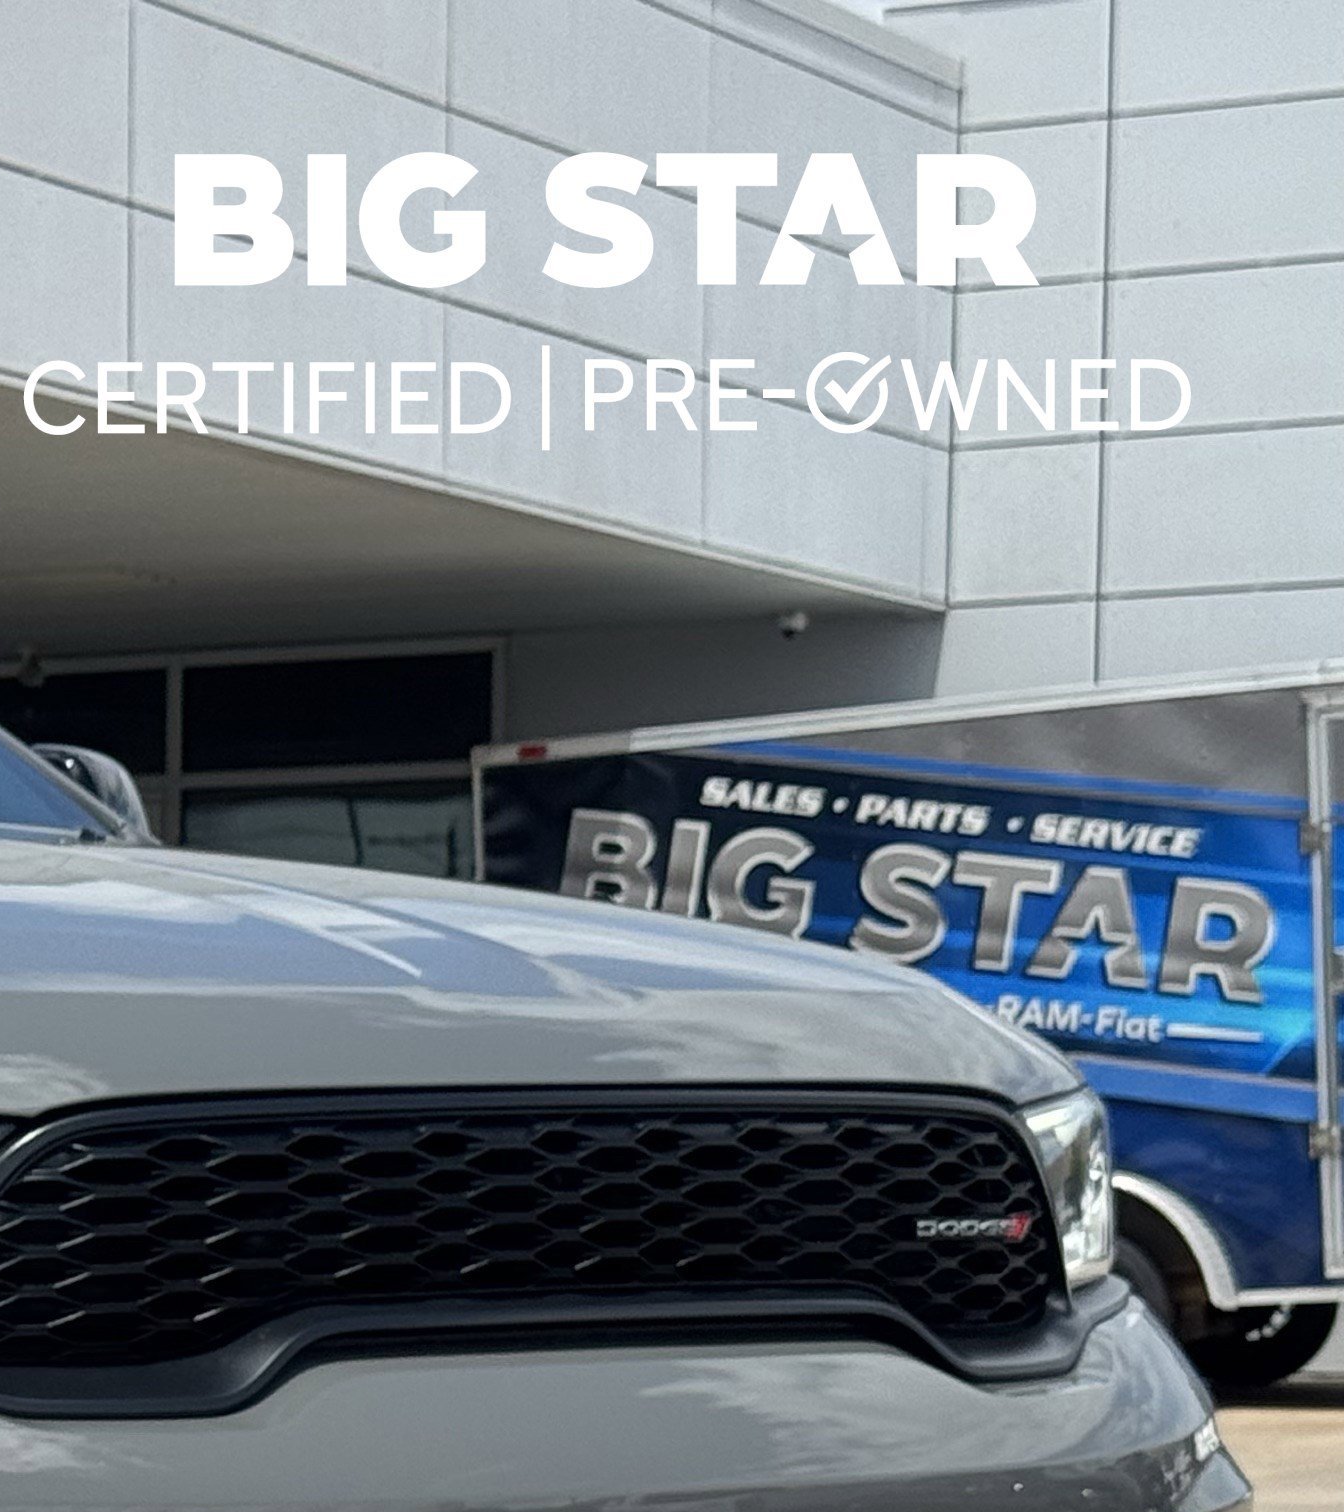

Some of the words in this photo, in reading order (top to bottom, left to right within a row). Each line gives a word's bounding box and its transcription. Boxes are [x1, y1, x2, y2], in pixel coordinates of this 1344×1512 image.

[700, 776, 827, 818] SALES
[855, 793, 992, 837] PARTS
[1030, 812, 1203, 860] SERVICE
[559, 807, 816, 941] BIG
[849, 843, 1277, 1003] STAR
[916, 1217, 1016, 1239] DODGE
